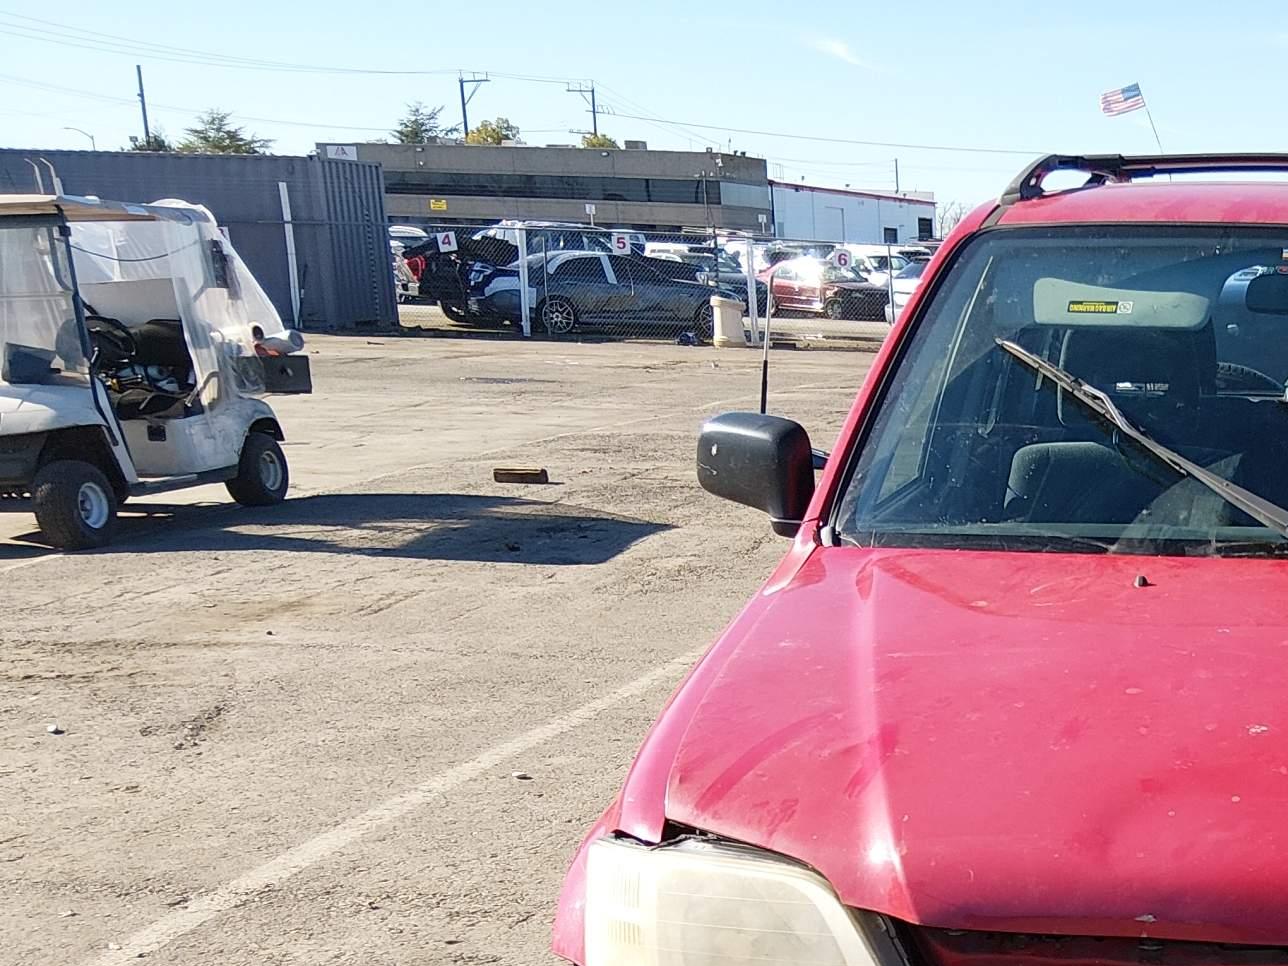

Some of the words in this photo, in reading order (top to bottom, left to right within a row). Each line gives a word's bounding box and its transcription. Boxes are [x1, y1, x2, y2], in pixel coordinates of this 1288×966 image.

[441, 233, 452, 247] 4
[616, 237, 627, 250] 5
[838, 253, 848, 266] 6
